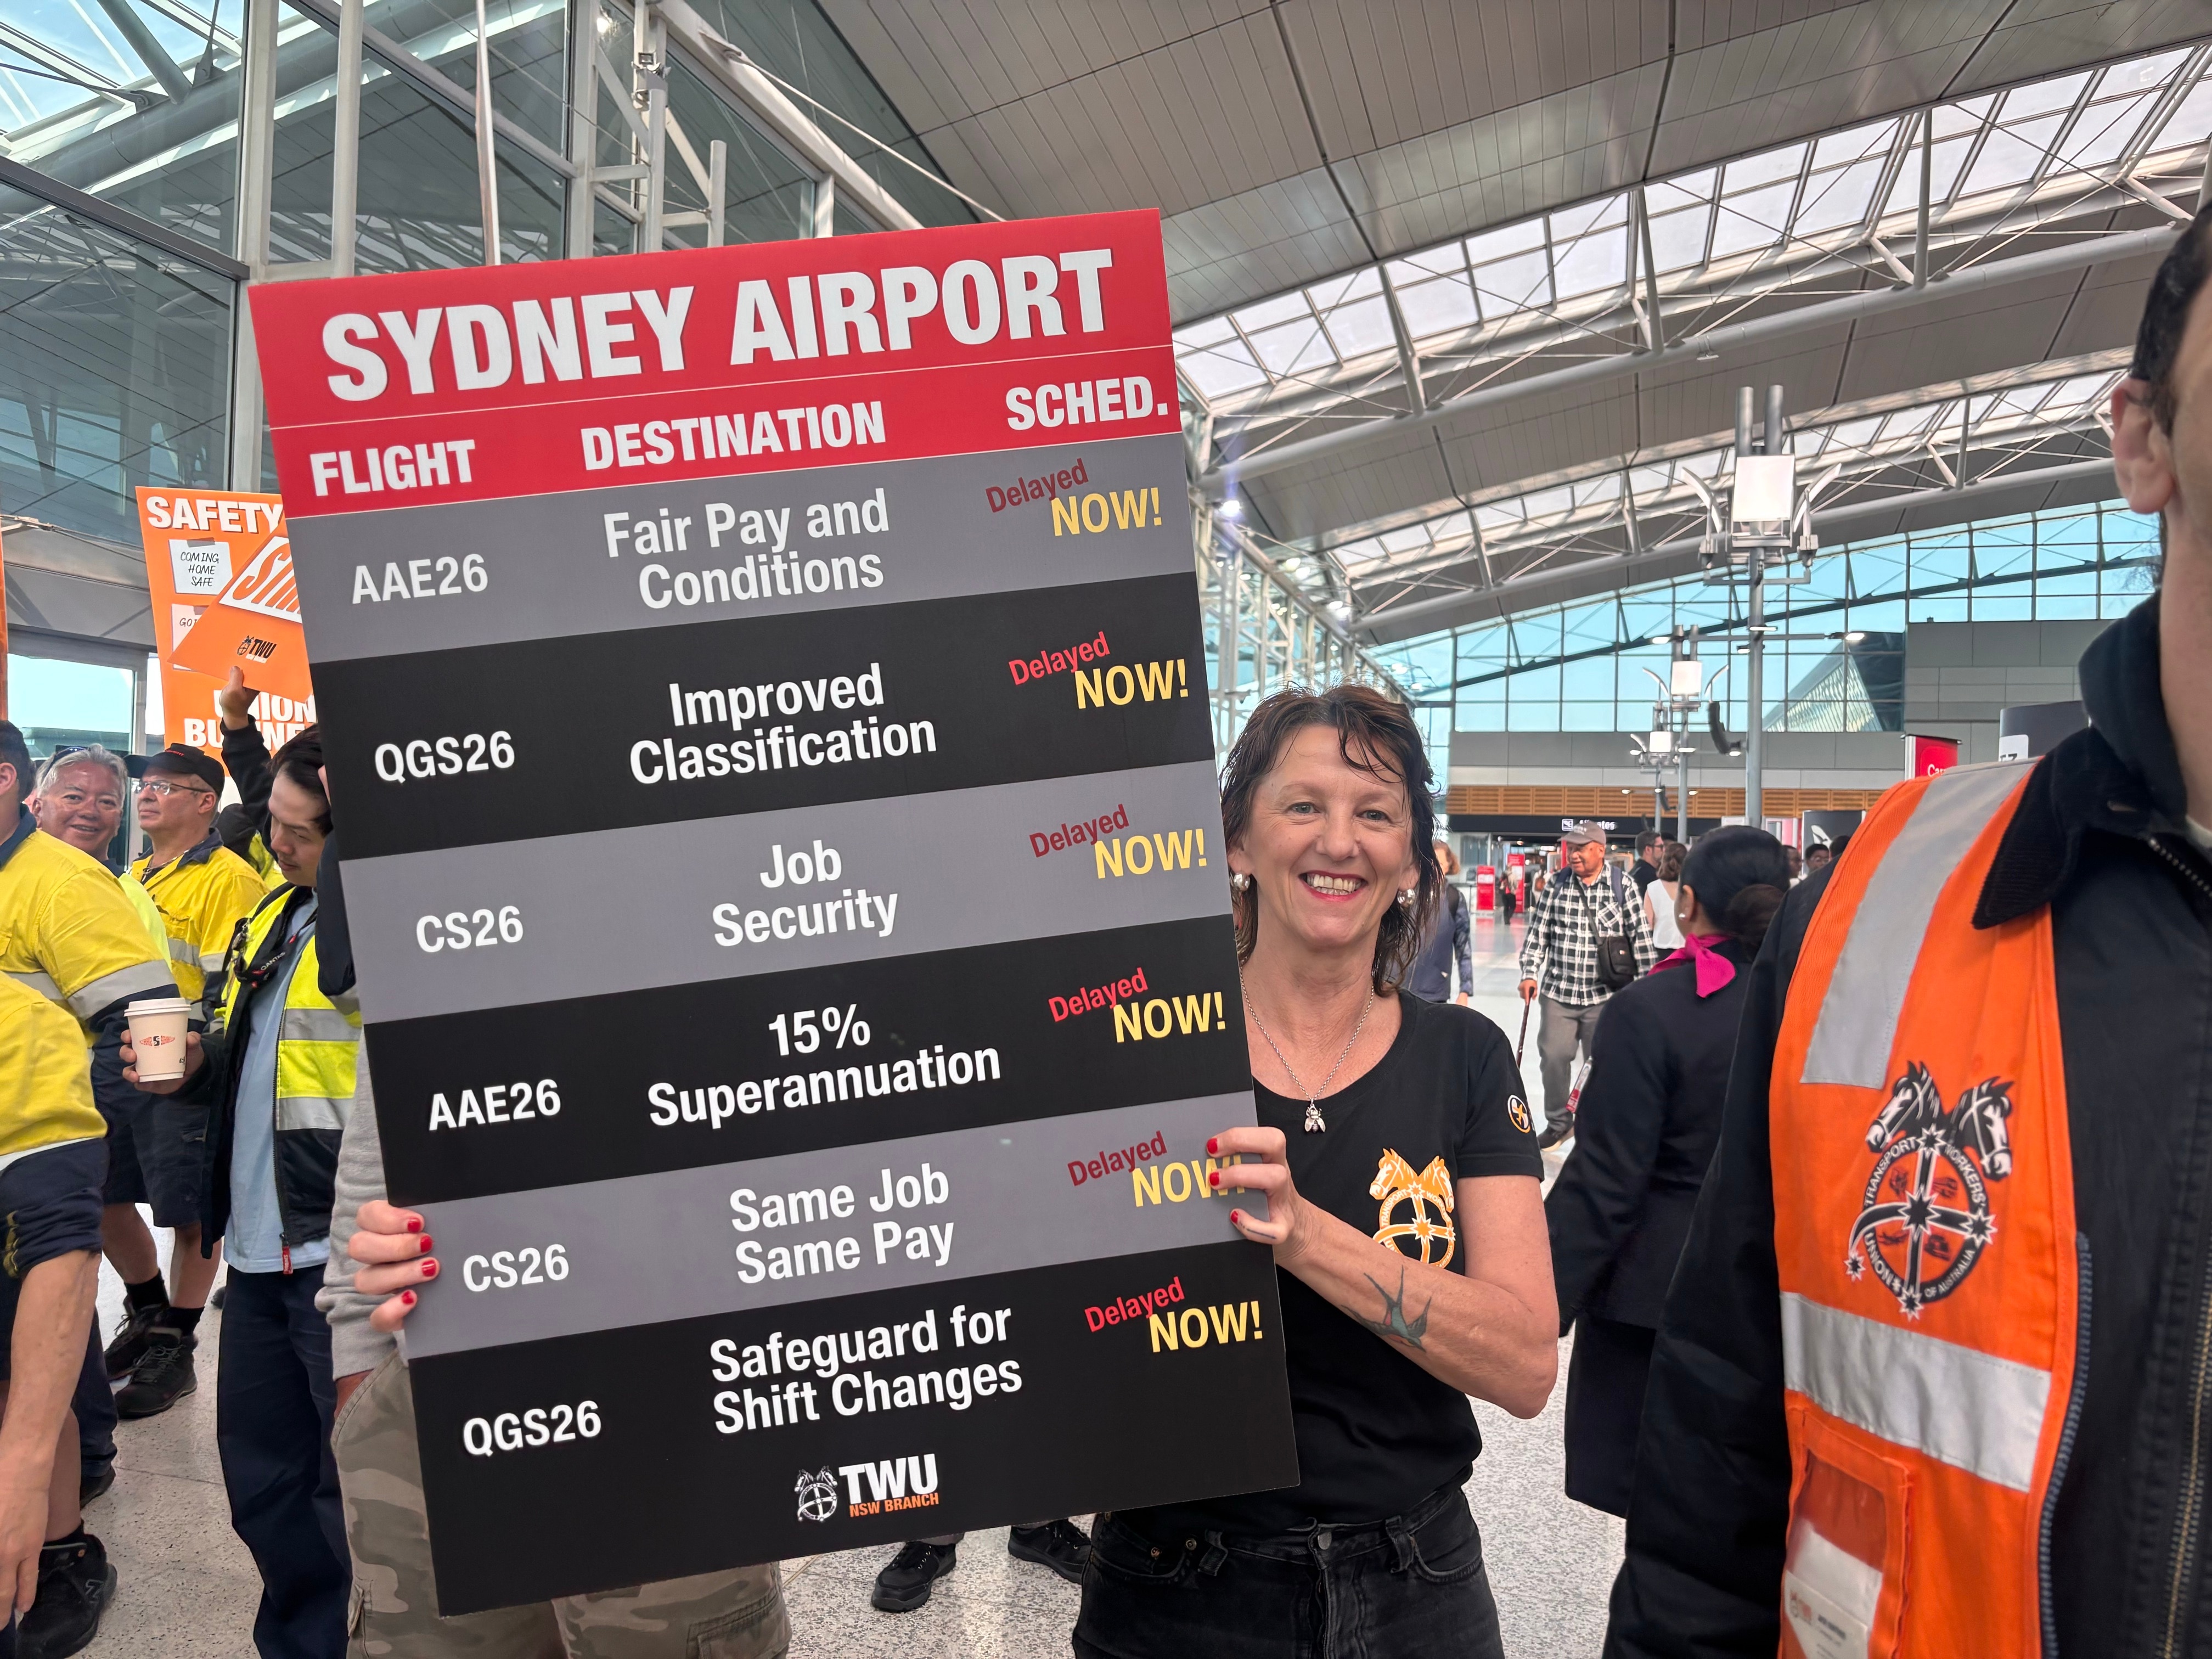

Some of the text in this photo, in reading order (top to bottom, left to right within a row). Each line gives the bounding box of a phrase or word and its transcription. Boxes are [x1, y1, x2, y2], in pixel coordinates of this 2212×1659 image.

[323, 249, 1112, 400] SYDNEY AIRPORT
[1006, 377, 1167, 430] SCHED.
[582, 402, 885, 470] DESTINATION
[311, 440, 474, 496] FLIGHT
[987, 459, 1088, 511] Delayed
[147, 496, 283, 533] SAFETY
[604, 488, 888, 557] Fair Pay and
[1052, 488, 1161, 536] NOW!
[181, 552, 219, 564] COMING
[188, 565, 216, 575] HOME
[191, 576, 213, 587] SAFE
[353, 554, 487, 604] AAE26
[640, 551, 883, 609] Conditions
[249, 639, 277, 659] TWU
[1009, 631, 1110, 685] Delayed
[669, 663, 883, 730] Improved
[1077, 660, 1187, 707] NOW!
[376, 731, 514, 783] QGS26
[631, 717, 936, 783] Classification
[1030, 804, 1129, 857] Delayed
[1095, 830, 1207, 879] NOW!
[760, 840, 841, 887] Job
[416, 906, 523, 952] CS26
[713, 889, 897, 946] Security
[261, 952, 286, 970] QANTAS
[1048, 967, 1148, 1022] Delayed
[1114, 993, 1225, 1042] NOW!
[769, 1004, 870, 1055] 15%
[430, 1079, 560, 1130] AAE26
[649, 1045, 1000, 1128] Superannuation
[1068, 1131, 1167, 1186] Delayed
[1865, 1136, 1918, 1206] TRANSPORT
[730, 1163, 948, 1231] Same Job
[1381, 1189, 1408, 1227] TRANSPORT
[464, 1244, 569, 1291] CS26
[736, 1222, 954, 1283] Same Pay
[1864, 1233, 1975, 1298] UNION OF AUSTRALIA
[1084, 1276, 1185, 1332] Delayed
[1150, 1302, 1262, 1352] NOW!
[711, 1305, 1011, 1381] Safeguard for
[714, 1361, 1021, 1433] Shift Changes
[464, 1401, 600, 1456] QGS26
[838, 1453, 938, 1505] TWU
[849, 1501, 880, 1517] NSW
[885, 1492, 939, 1512] BRANCH
